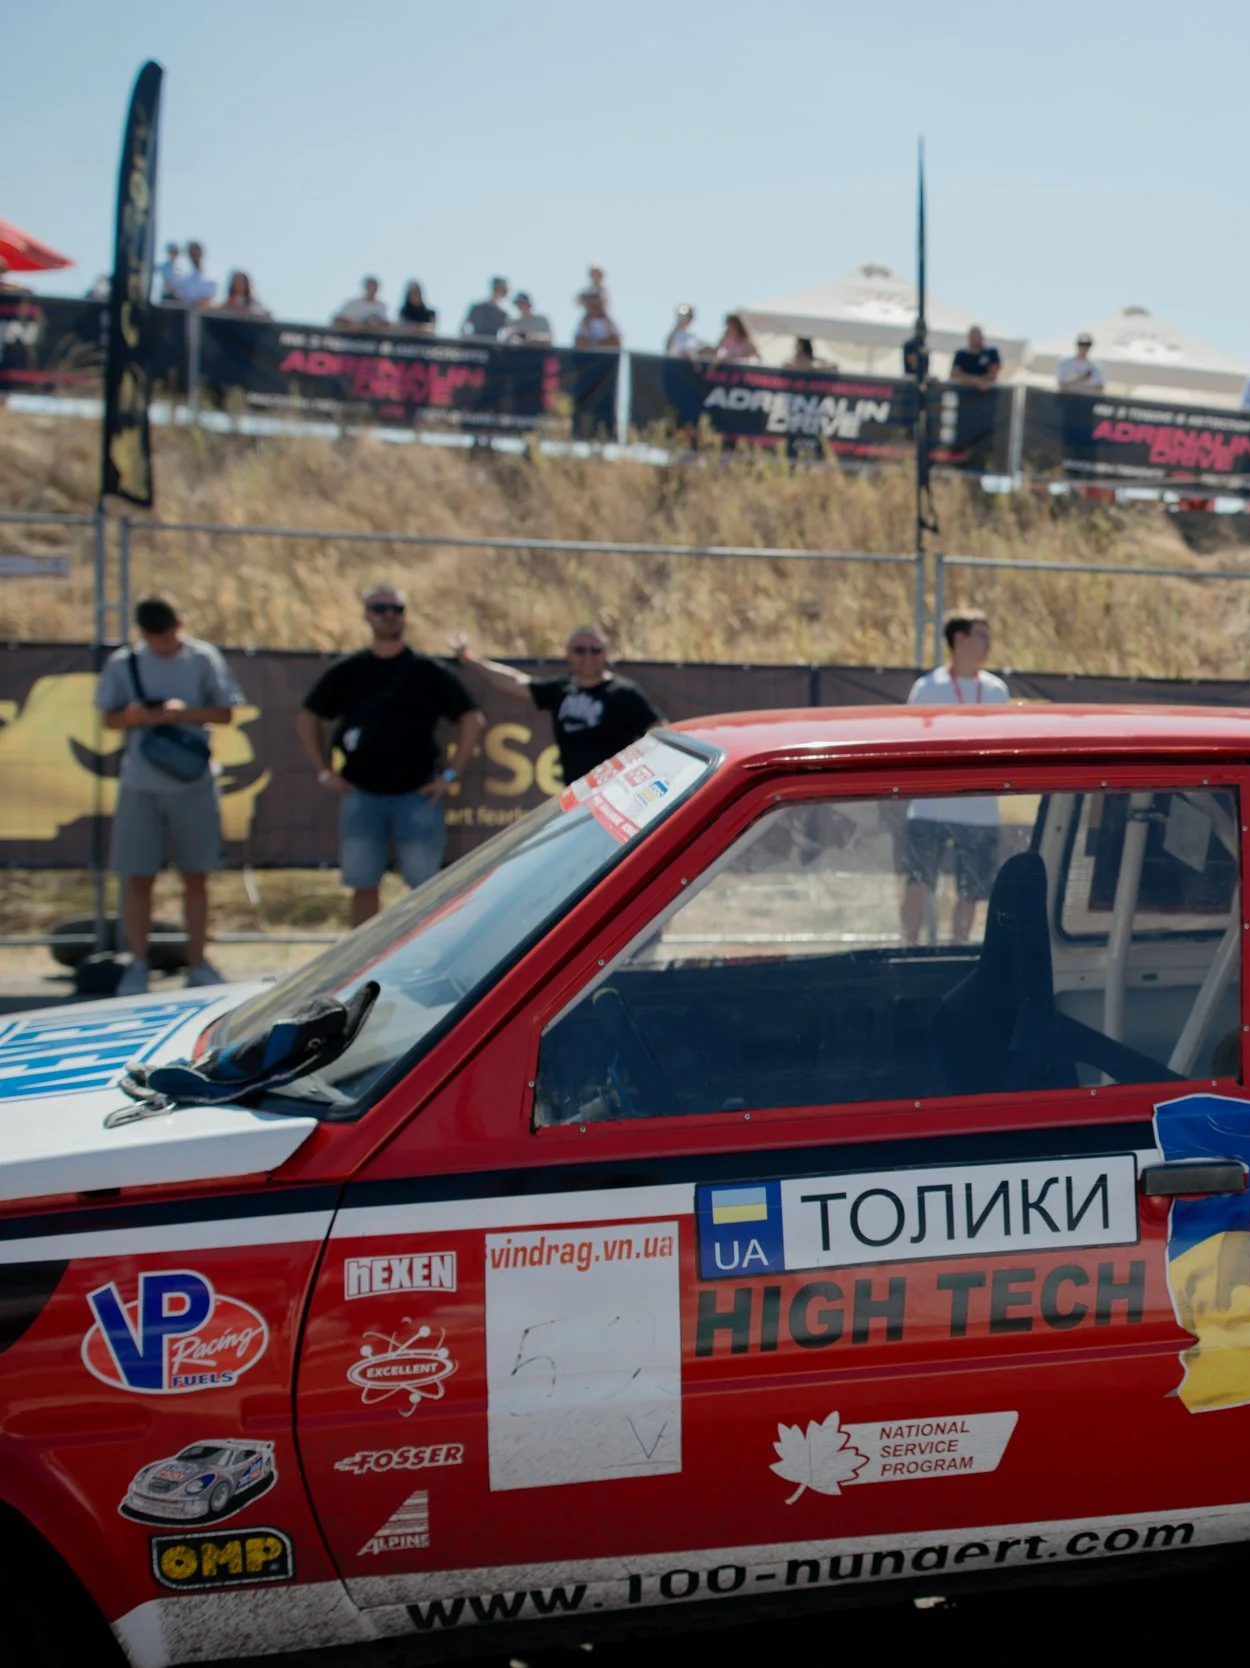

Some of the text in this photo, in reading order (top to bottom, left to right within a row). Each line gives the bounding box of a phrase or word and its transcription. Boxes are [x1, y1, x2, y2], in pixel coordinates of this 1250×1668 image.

[703, 386, 891, 423] ADRENALIN
[765, 410, 862, 440] DRIVE
[1148, 443, 1235, 472] DRIVE
[800, 1173, 1110, 1252] ТОЛИКИ
[489, 1234, 673, 1272] vindrag.vn.ua
[714, 1238, 769, 1271] UA
[696, 1260, 1146, 1357] HIGH TECH
[89, 1271, 213, 1391] VP
[172, 1326, 260, 1375] Racing
[172, 1371, 234, 1388] FUELS
[365, 1362, 438, 1378] EXCELLENT
[878, 1420, 971, 1440] NATIONAL
[355, 1444, 463, 1470] FOSSER
[879, 1439, 959, 1459] SERVICE
[879, 1455, 974, 1478] PROGRAM
[160, 1536, 283, 1581] OMP
[359, 1532, 430, 1555] ALPINE
